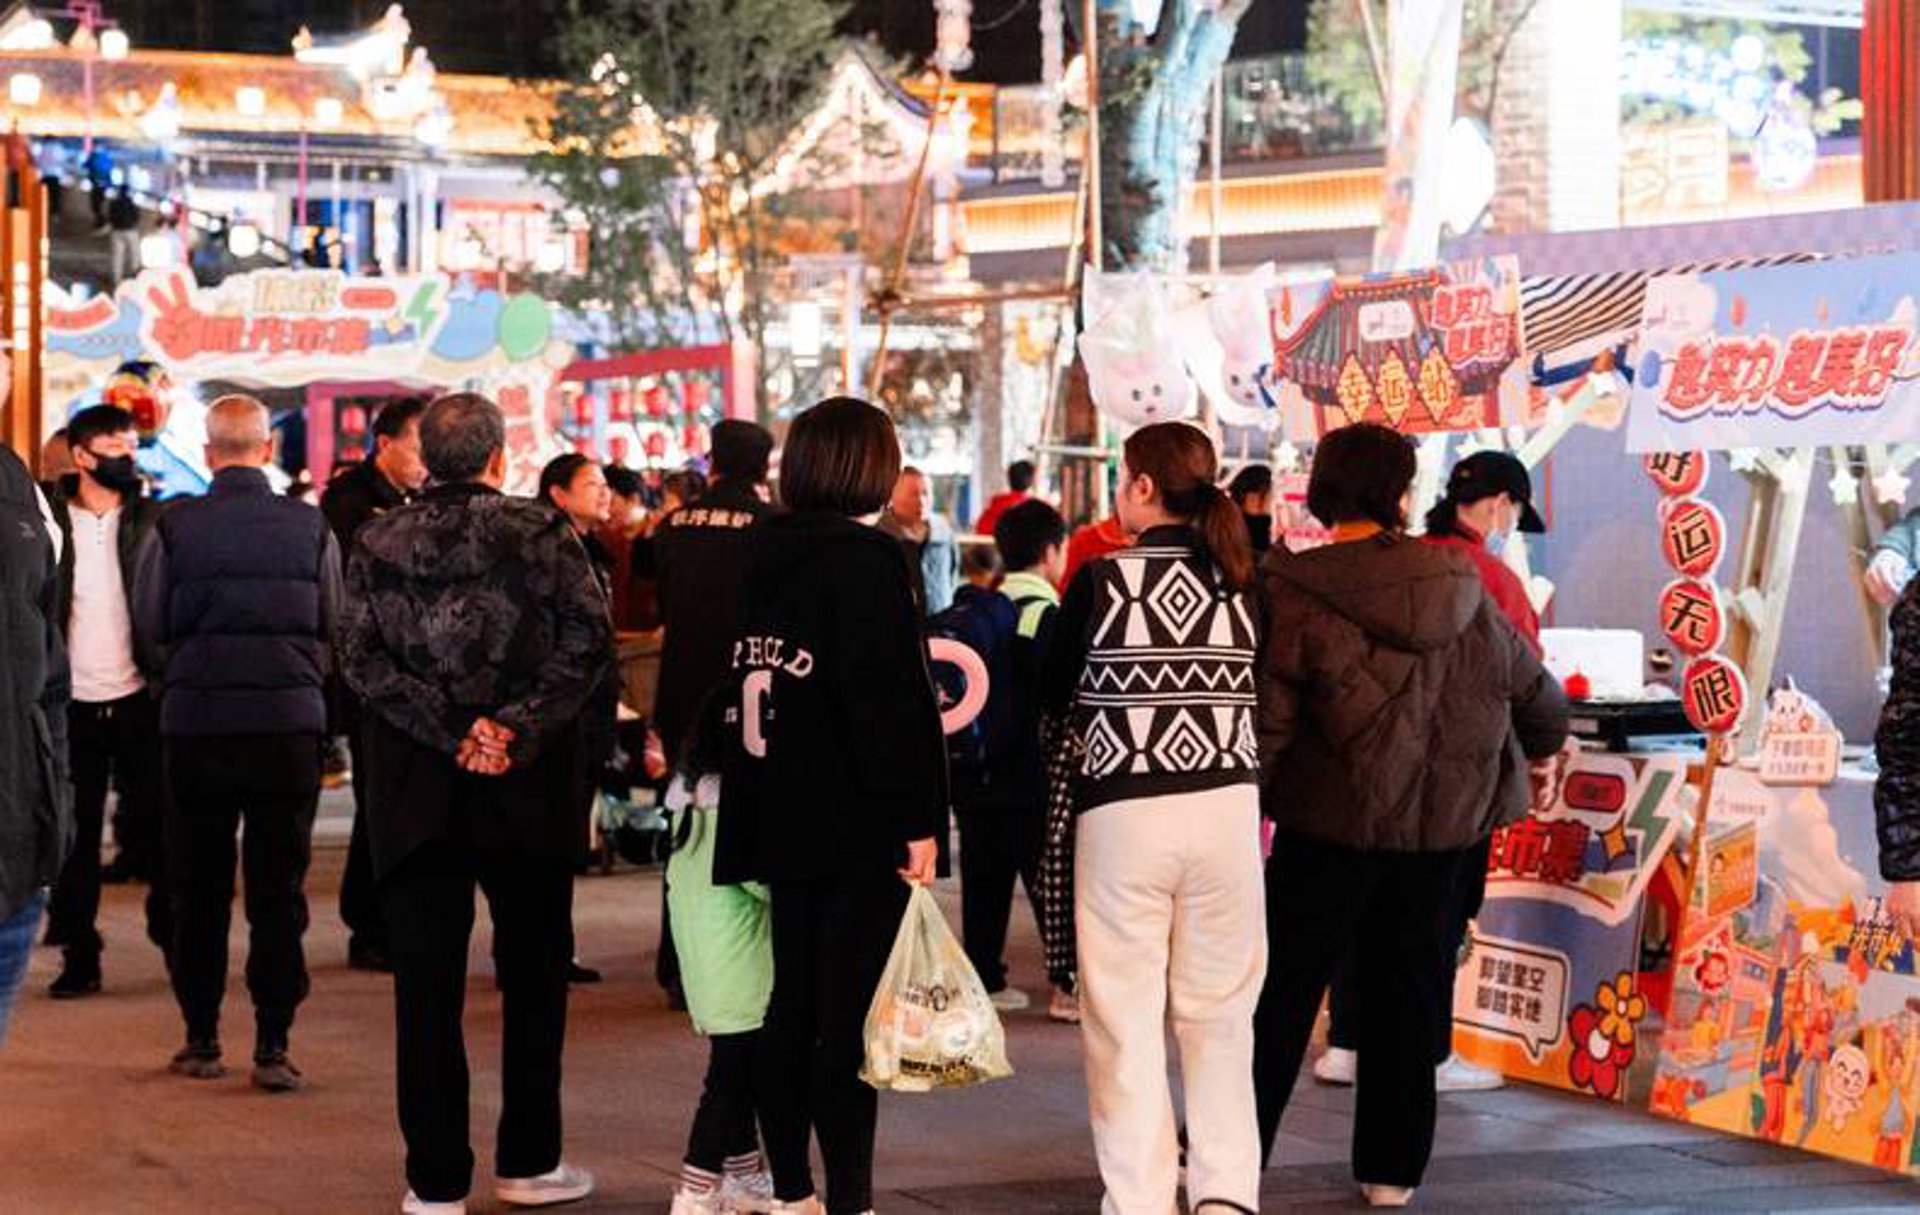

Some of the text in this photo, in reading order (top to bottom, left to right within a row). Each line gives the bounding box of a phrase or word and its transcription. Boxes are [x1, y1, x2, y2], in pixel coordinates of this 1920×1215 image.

[1649, 451, 1735, 723] 好运无限
[1479, 956, 1547, 993] 仰望星空
[1475, 984, 1543, 1024] 脚踏实地
